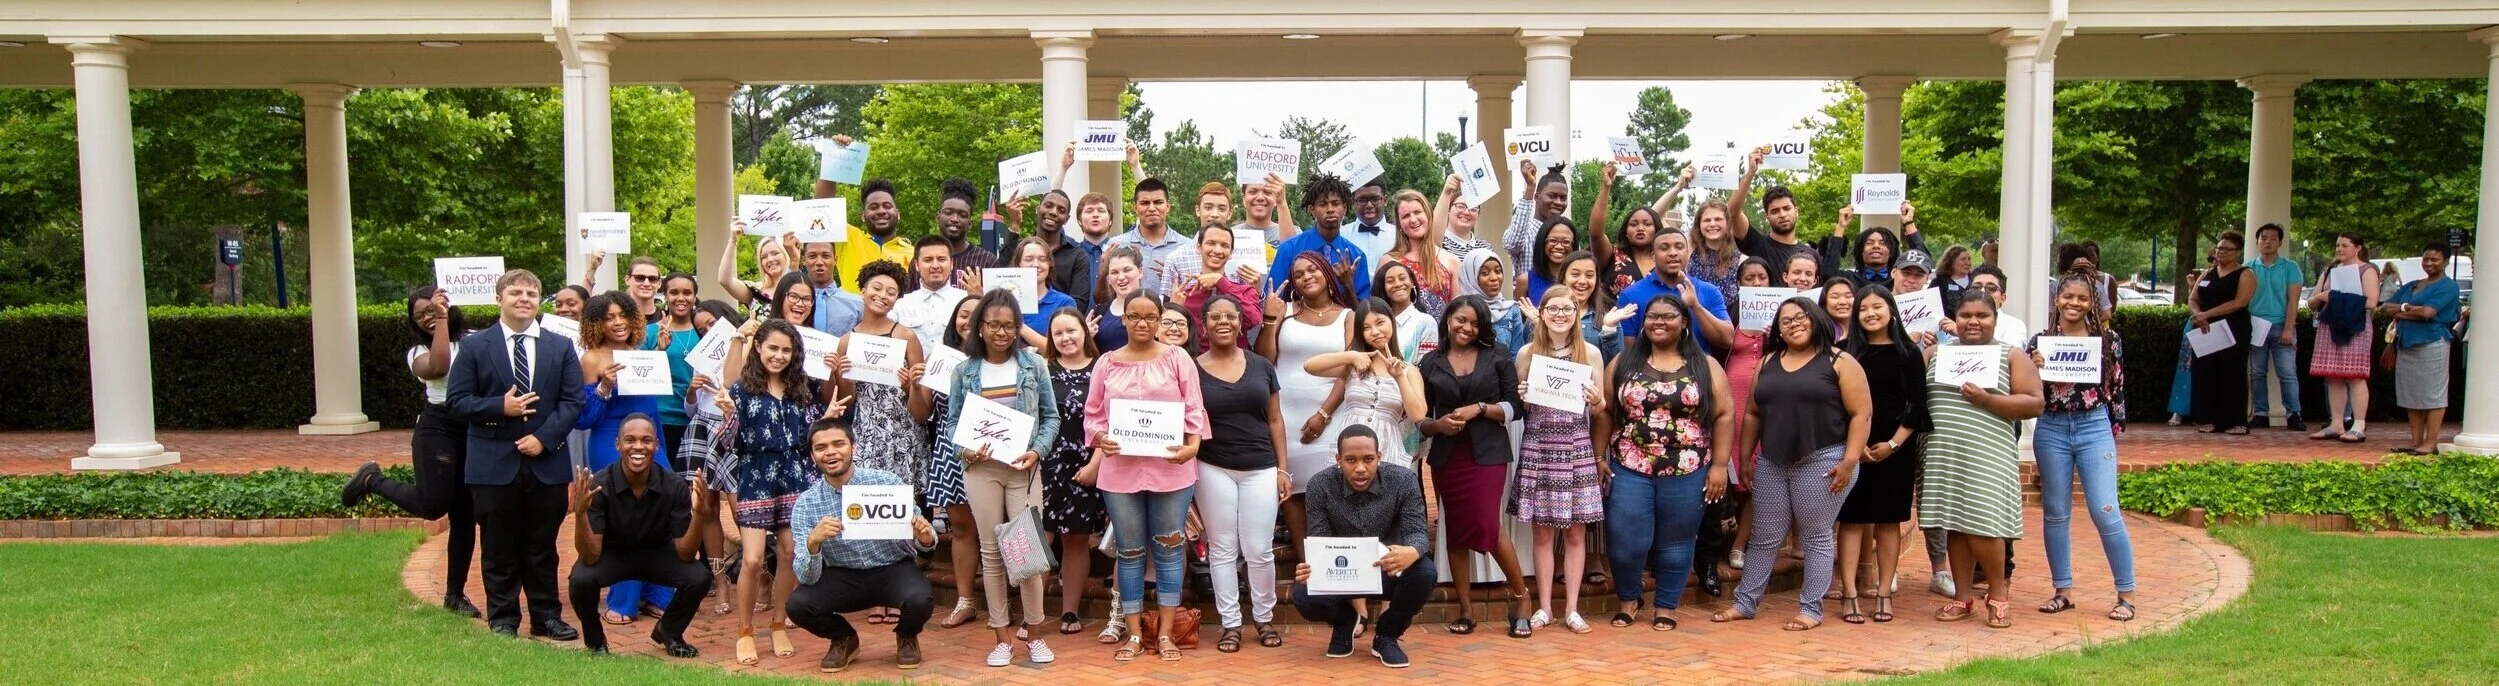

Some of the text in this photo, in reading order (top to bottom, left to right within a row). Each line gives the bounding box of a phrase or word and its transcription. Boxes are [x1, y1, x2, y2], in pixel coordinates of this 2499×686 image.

[1084, 134, 1116, 143] JMU
[1519, 140, 1550, 153] VCU
[1774, 143, 1804, 154] VCU
[1246, 150, 1297, 164] RADFORD
[1246, 161, 1296, 174] UNIVERSITY
[1014, 176, 1047, 186] DOMINION
[446, 274, 501, 285] RADFORD
[448, 285, 497, 295] UNIVERSIT
[1741, 301, 1780, 311] RADFO
[1742, 312, 1774, 320] UNIVER
[1901, 304, 1932, 328] Tyler
[708, 340, 725, 360] VT
[2049, 352, 2088, 361] JMU
[864, 351, 886, 364] VT
[632, 366, 653, 377] VT
[1950, 358, 1987, 379] Tyler
[1546, 375, 1570, 389] VT
[1535, 388, 1560, 396] VIRGINIA
[974, 420, 1011, 441] Tyler
[1113, 428, 1175, 441] OLD DOMINION
[864, 504, 906, 519] VCU
